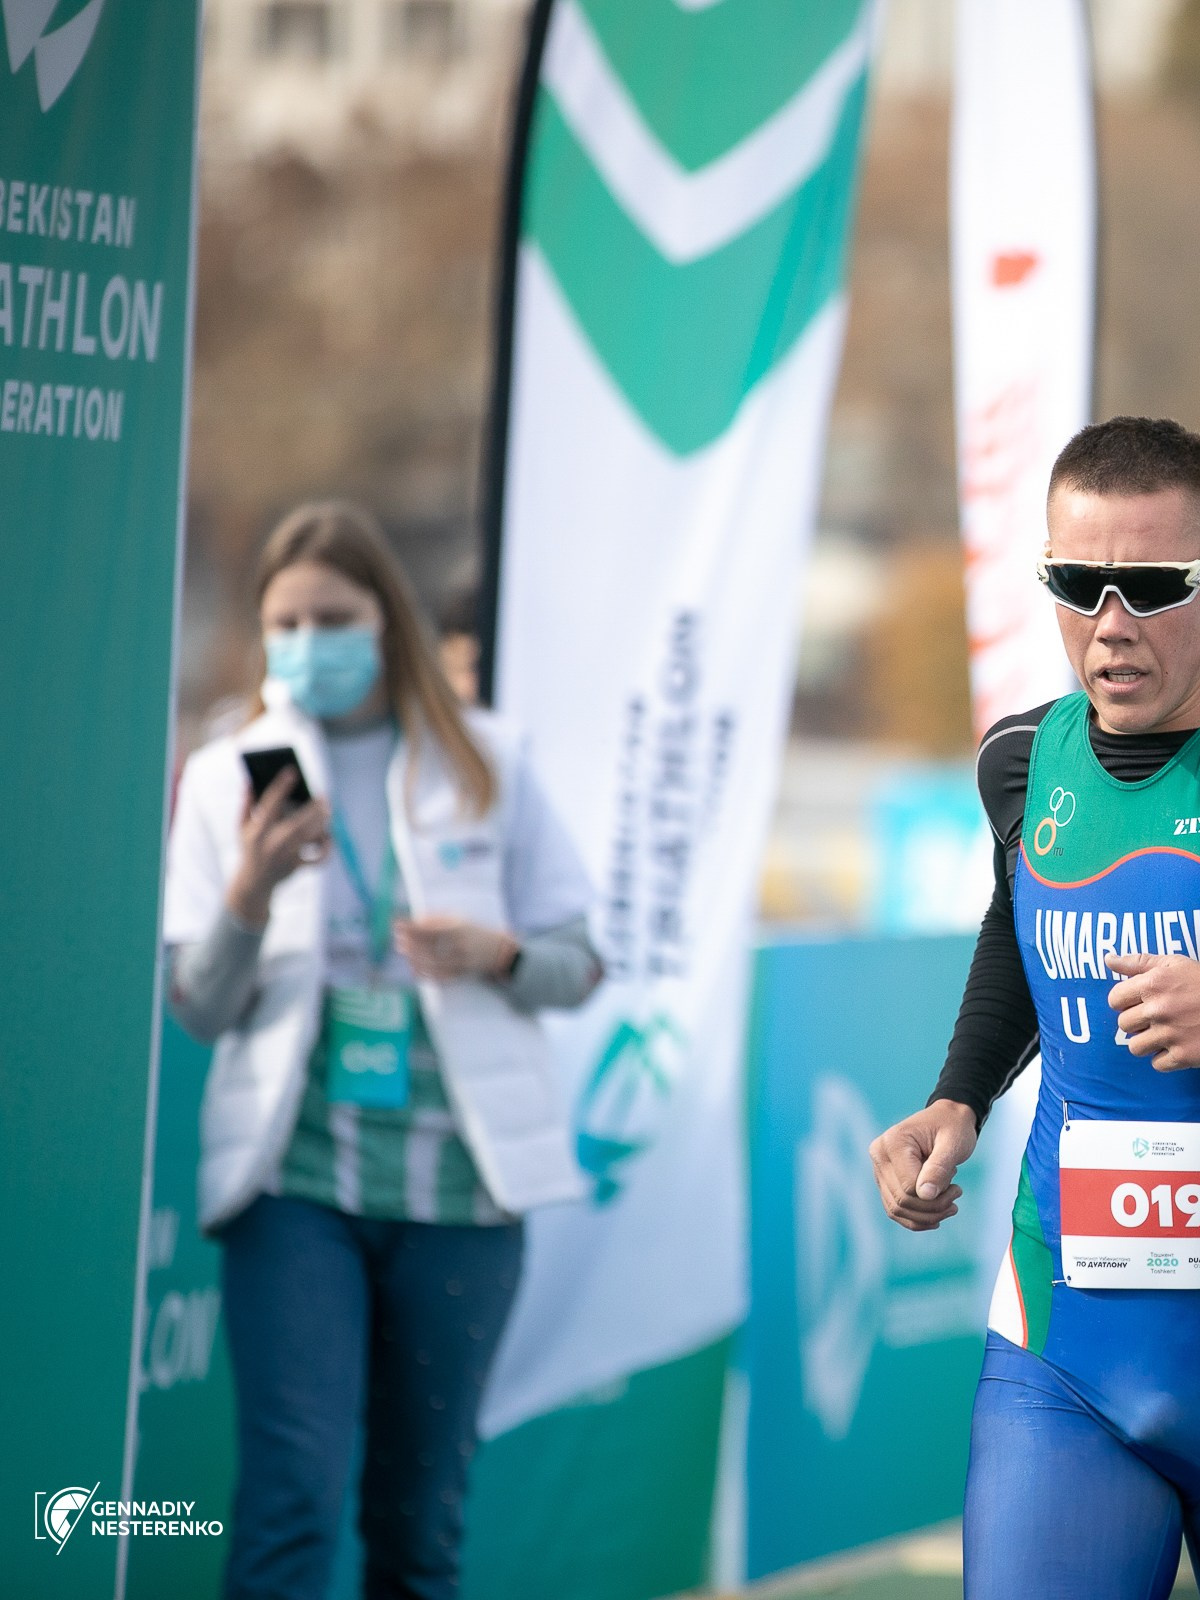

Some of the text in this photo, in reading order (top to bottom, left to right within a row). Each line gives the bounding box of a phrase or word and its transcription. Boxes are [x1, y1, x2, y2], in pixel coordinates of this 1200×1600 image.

[0, 180, 137, 249] EKISTAN
[1053, 847, 1064, 857] ITU
[1146, 1258, 1179, 1267] 2020
